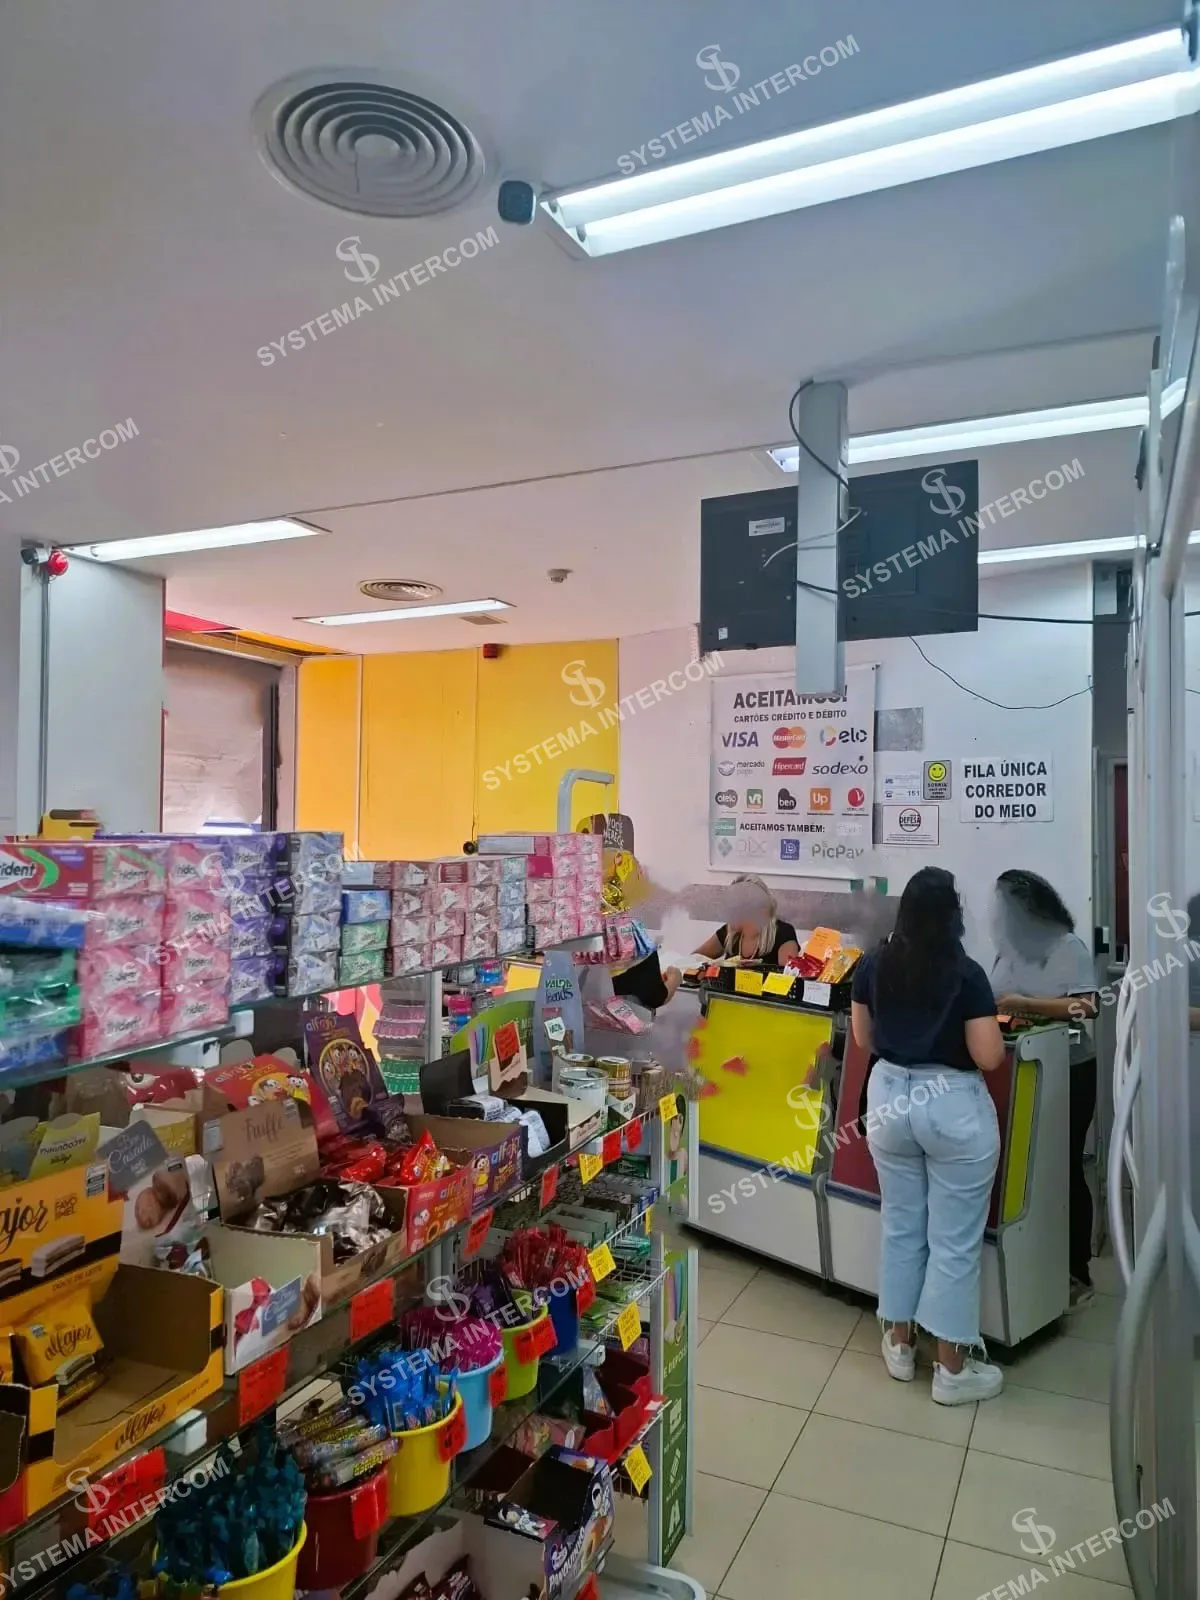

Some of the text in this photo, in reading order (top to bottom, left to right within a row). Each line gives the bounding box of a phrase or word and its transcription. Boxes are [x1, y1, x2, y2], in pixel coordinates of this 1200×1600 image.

[734, 713, 769, 723] CARTÕES
[772, 711, 806, 721] CRÉDITO
[816, 709, 847, 720] DÉBITO
[722, 732, 759, 748] VISA
[838, 728, 868, 744] elo
[736, 760, 766, 768] mercado
[812, 762, 868, 775] sodexo
[964, 760, 1047, 778] FILA ÚNICA
[966, 782, 1046, 798] CORREDOR
[779, 798, 794, 807] ben
[975, 804, 1036, 818] DO MEIO
[740, 822, 784, 832] ACEITAMOS
[787, 822, 825, 833] TAMBÉM:
[44, 1324, 92, 1361] alfajor
[114, 1402, 167, 1452] alfajor
